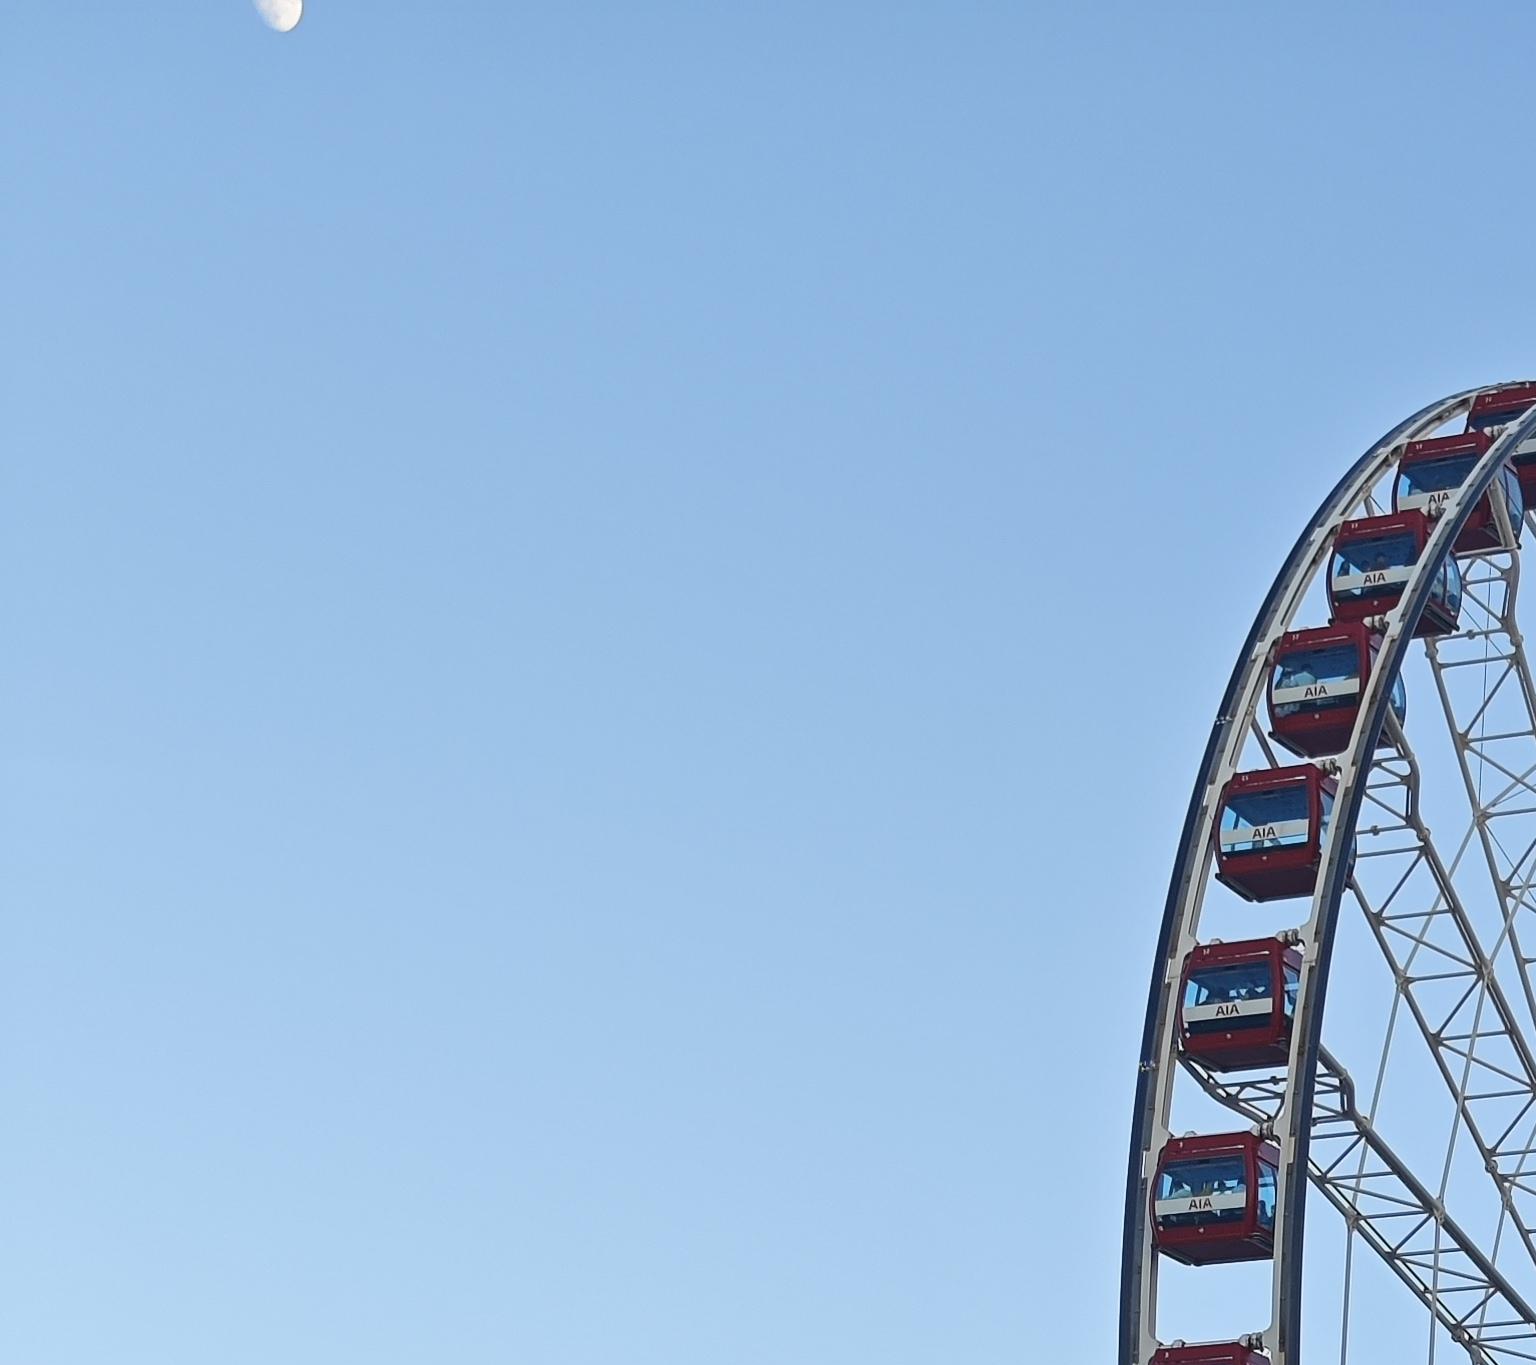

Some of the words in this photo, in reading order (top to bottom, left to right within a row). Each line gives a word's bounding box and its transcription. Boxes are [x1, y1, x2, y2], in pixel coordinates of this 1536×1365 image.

[1428, 492, 1450, 505] AIA
[1363, 572, 1386, 586] AIA
[1304, 685, 1328, 698] AIA
[1252, 826, 1277, 839] AIA
[1216, 1003, 1240, 1017] AIA
[1188, 1197, 1212, 1210] AIA
